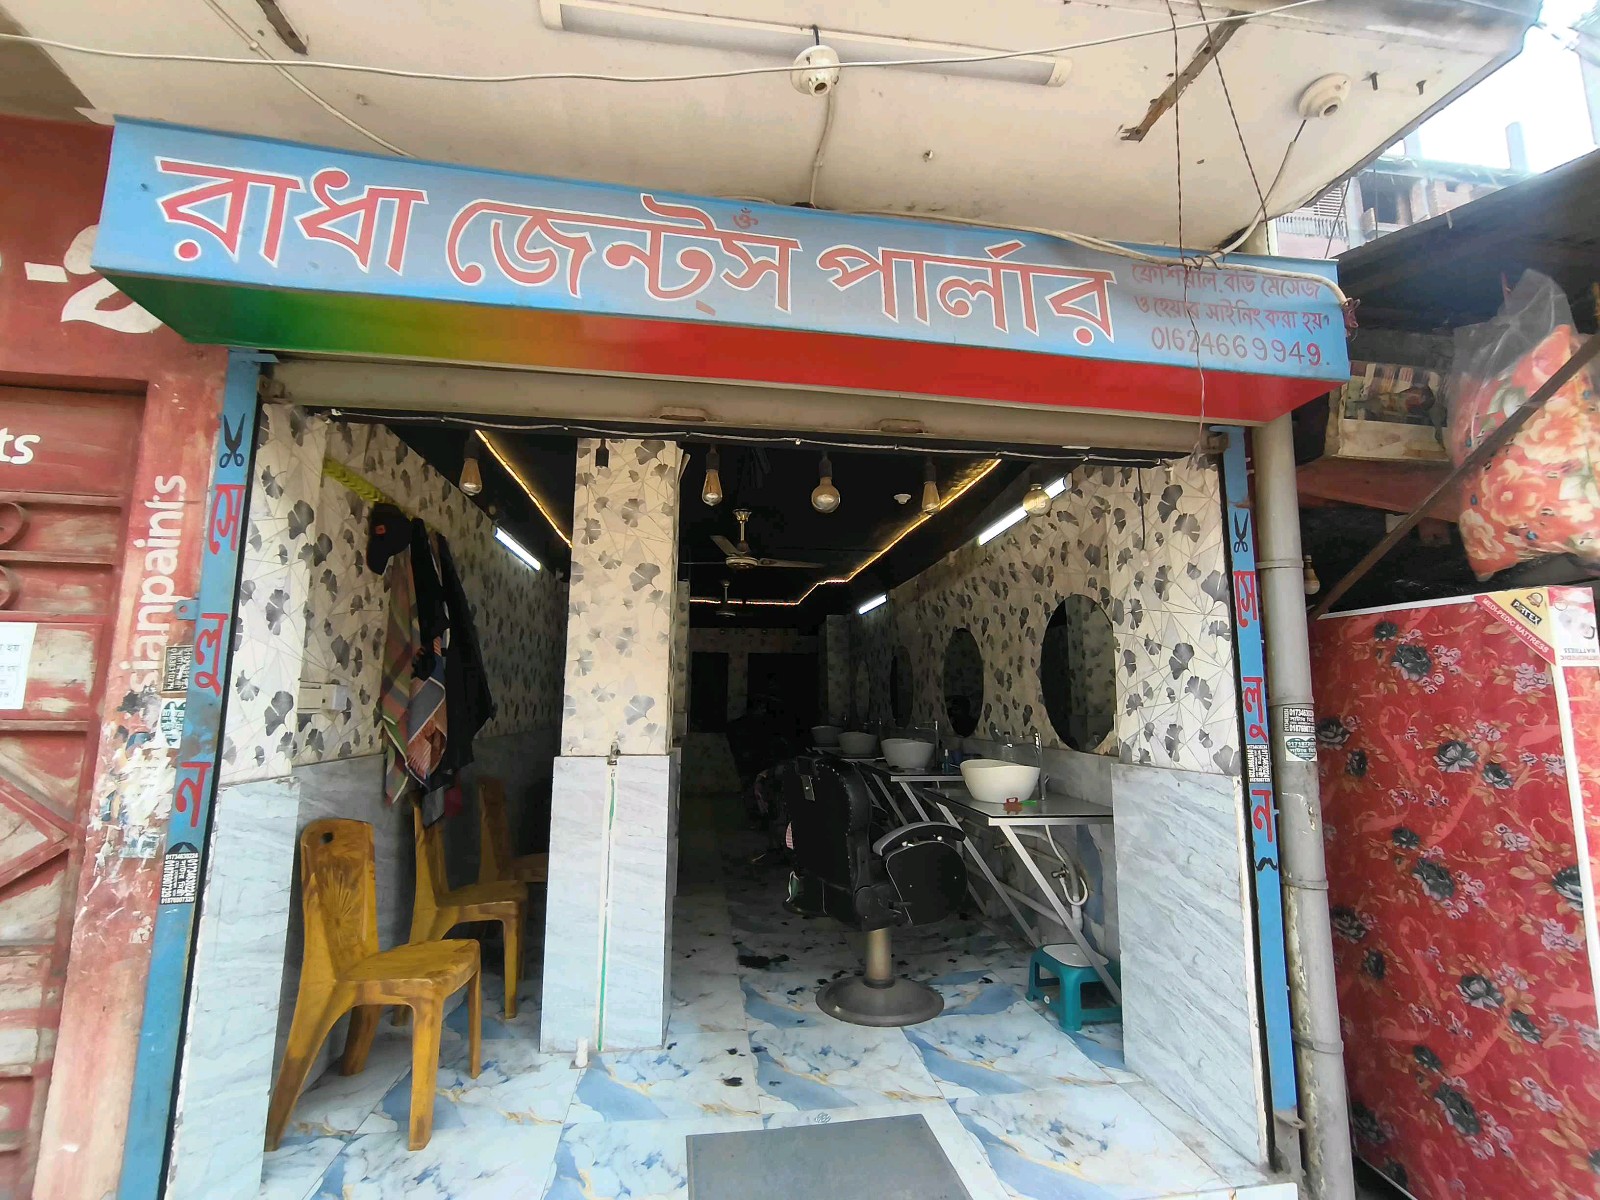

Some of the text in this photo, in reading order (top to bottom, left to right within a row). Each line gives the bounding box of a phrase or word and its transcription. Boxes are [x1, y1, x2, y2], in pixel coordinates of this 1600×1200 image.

[155, 156, 429, 277] রাধা
[816, 240, 1117, 346] পার্লার
[1263, 309, 1299, 329] করা
[1514, 623, 1550, 654] MATTRESS
